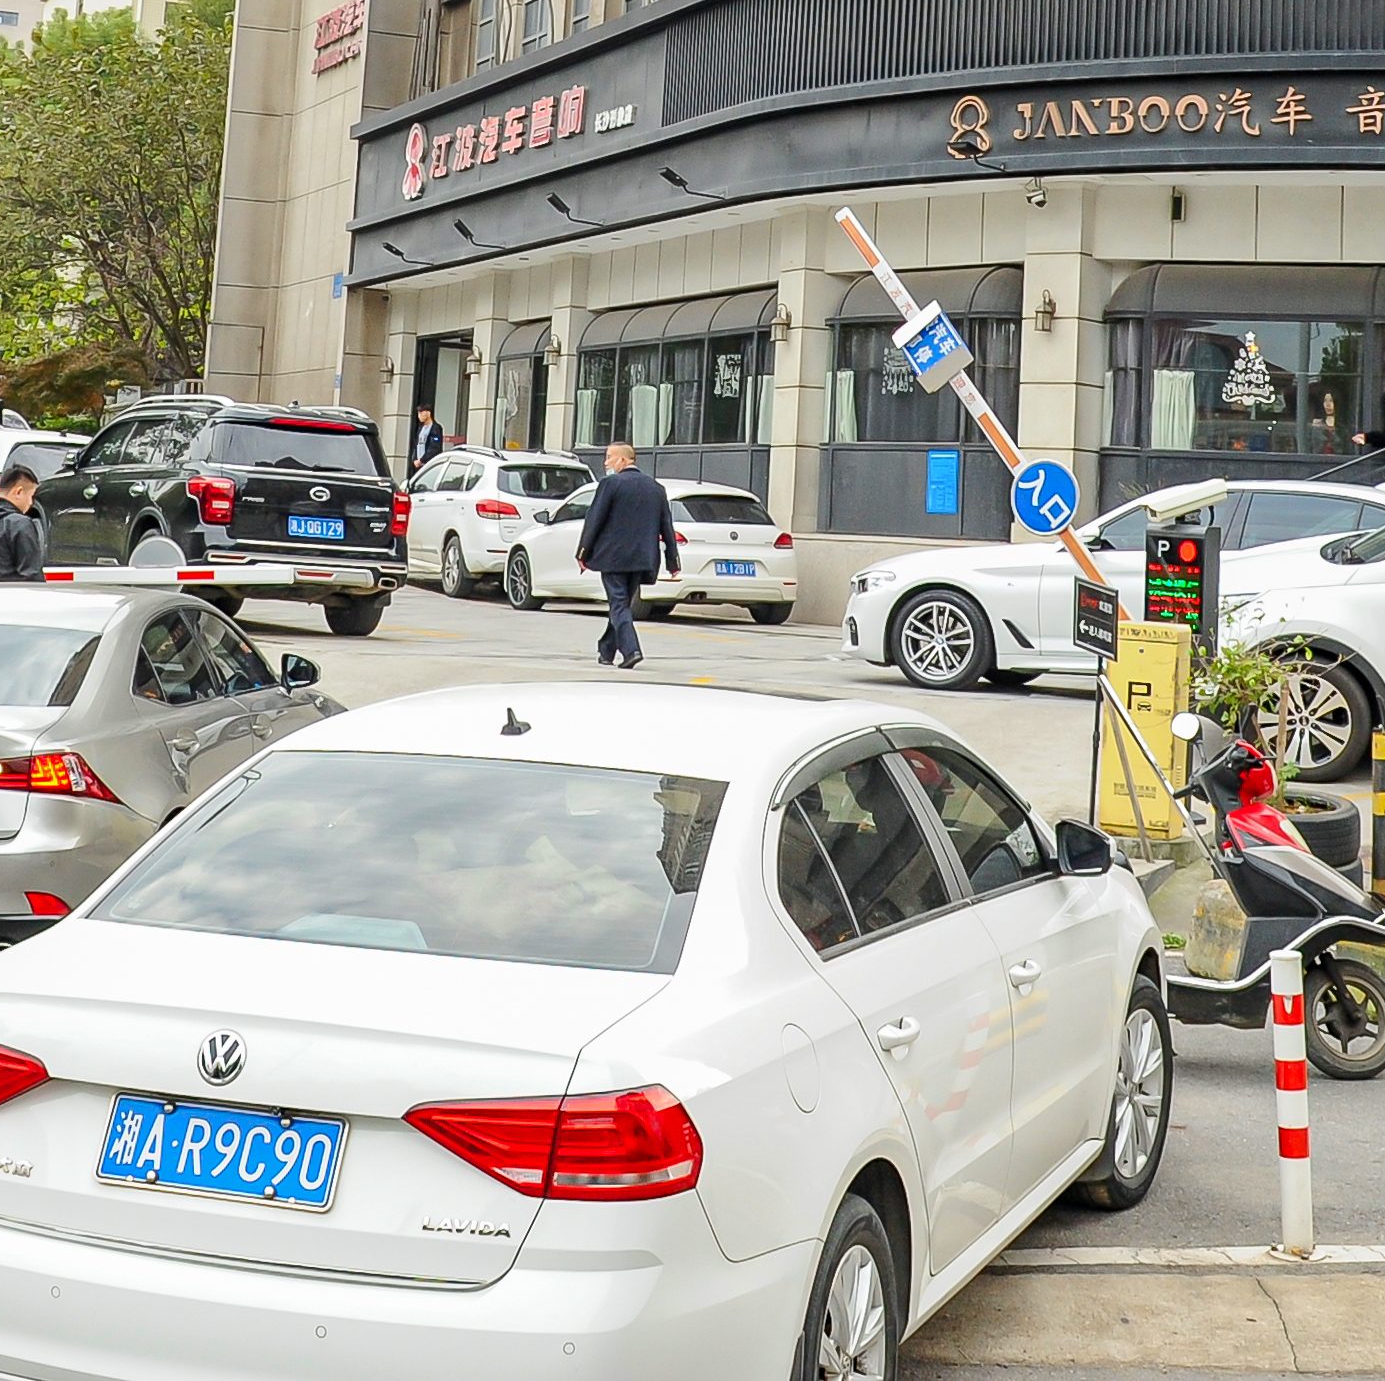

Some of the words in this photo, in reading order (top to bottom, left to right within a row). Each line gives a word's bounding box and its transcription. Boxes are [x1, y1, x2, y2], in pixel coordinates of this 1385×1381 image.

[429, 84, 587, 179] 江波汽车音响
[1013, 93, 1208, 141] JANBOO
[1018, 470, 1071, 529] 入口
[1158, 540, 1170, 558] P
[1127, 681, 1151, 709] P
[110, 1108, 334, 1192] 湘A·R9C90
[422, 1216, 511, 1238] LAVIDA
